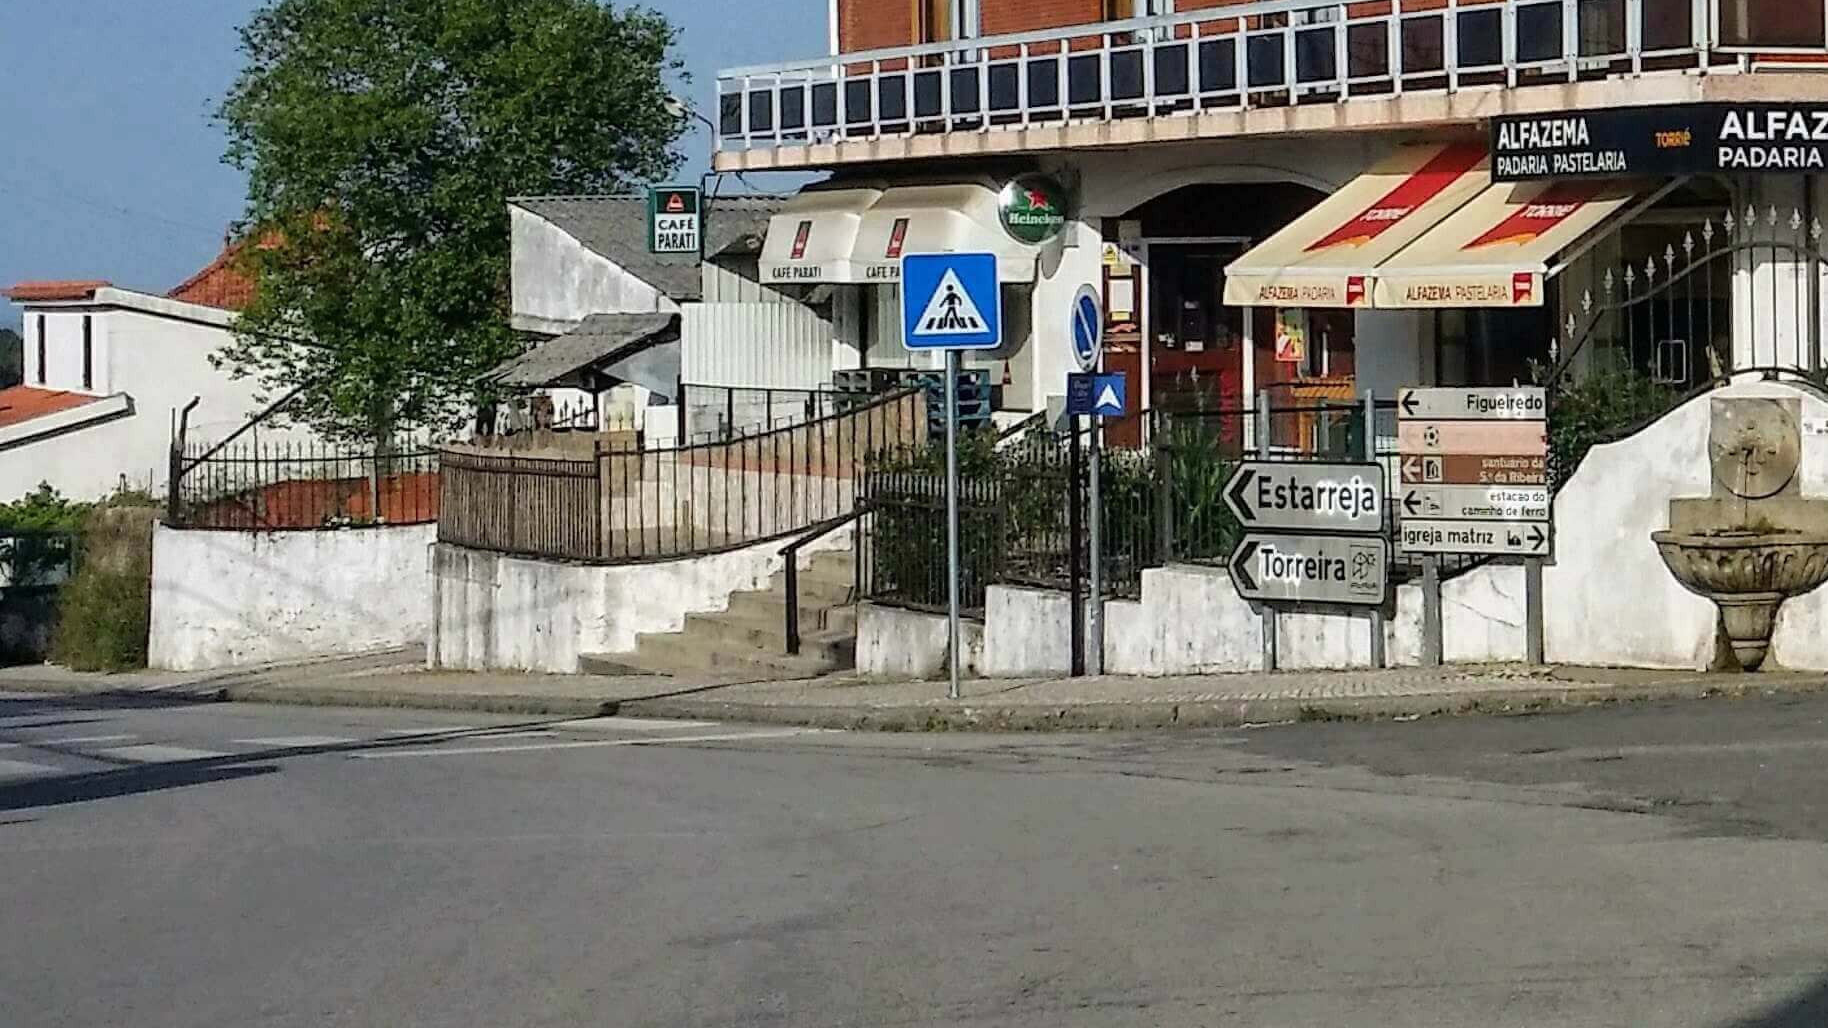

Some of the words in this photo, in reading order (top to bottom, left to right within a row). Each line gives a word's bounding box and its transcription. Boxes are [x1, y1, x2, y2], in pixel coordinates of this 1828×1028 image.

[1497, 117, 1590, 150] ALFAZEMA
[1498, 154, 1548, 176] PADARIA
[1553, 150, 1627, 173] PASTELARIA
[1718, 147, 1824, 169] PADARIA
[658, 216, 694, 230] CAFÉ
[658, 233, 695, 249] PARATI
[1406, 286, 1451, 301] ALFAZEMA
[1456, 286, 1508, 300] PASTELARIA
[1467, 394, 1543, 412] Figueiredo
[1258, 476, 1375, 518] Estarreja
[1404, 527, 1443, 546] igreja
[1448, 528, 1494, 544] matriz
[1261, 548, 1346, 581] Torreira
